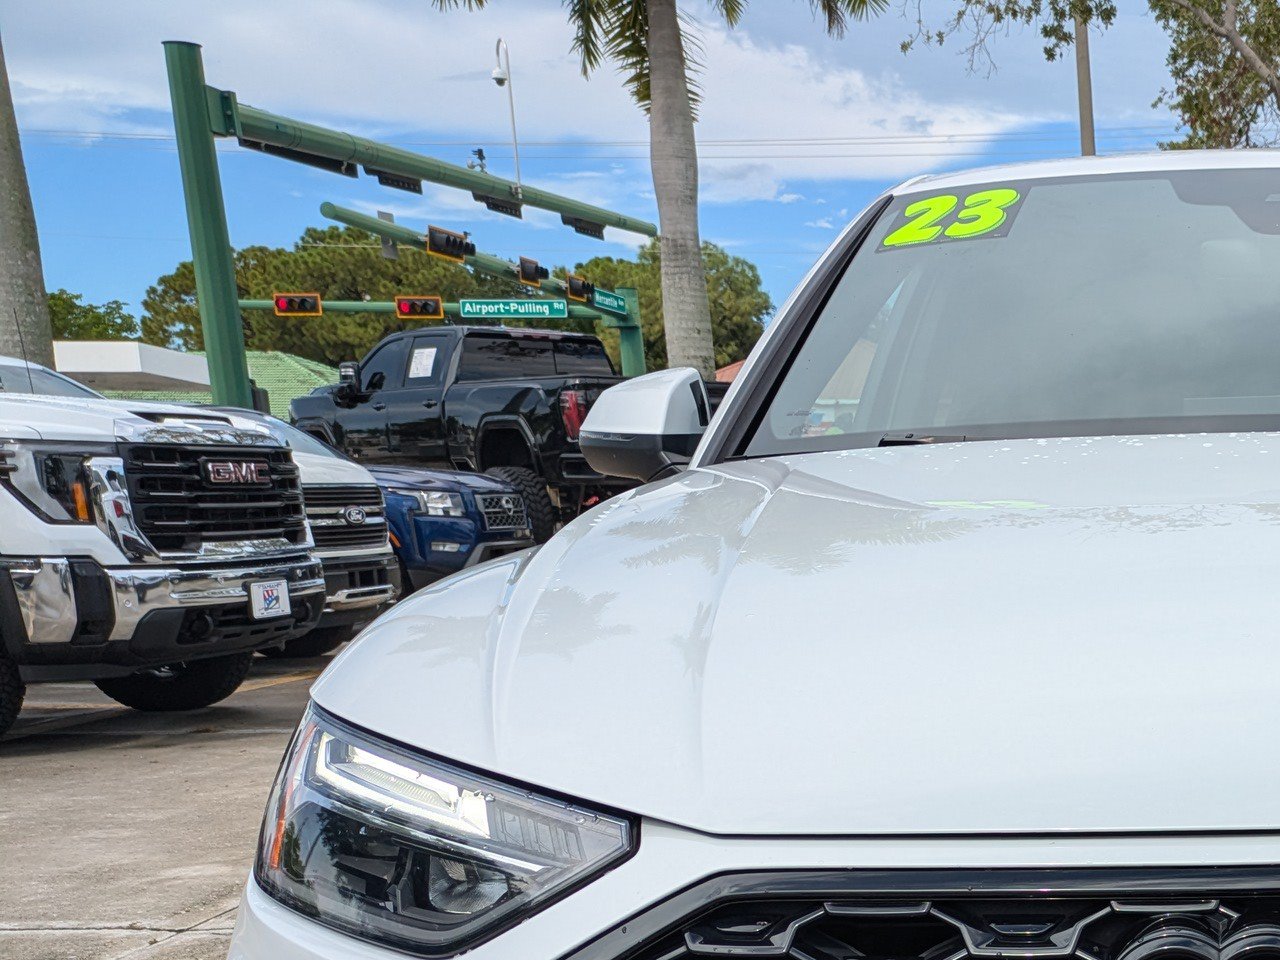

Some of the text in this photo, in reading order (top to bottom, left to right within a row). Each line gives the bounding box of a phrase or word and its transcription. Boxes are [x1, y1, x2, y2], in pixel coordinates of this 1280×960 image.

[883, 188, 1020, 247] 23
[464, 302, 565, 315] Airport-Pulling Rd
[207, 462, 270, 483] GMC
